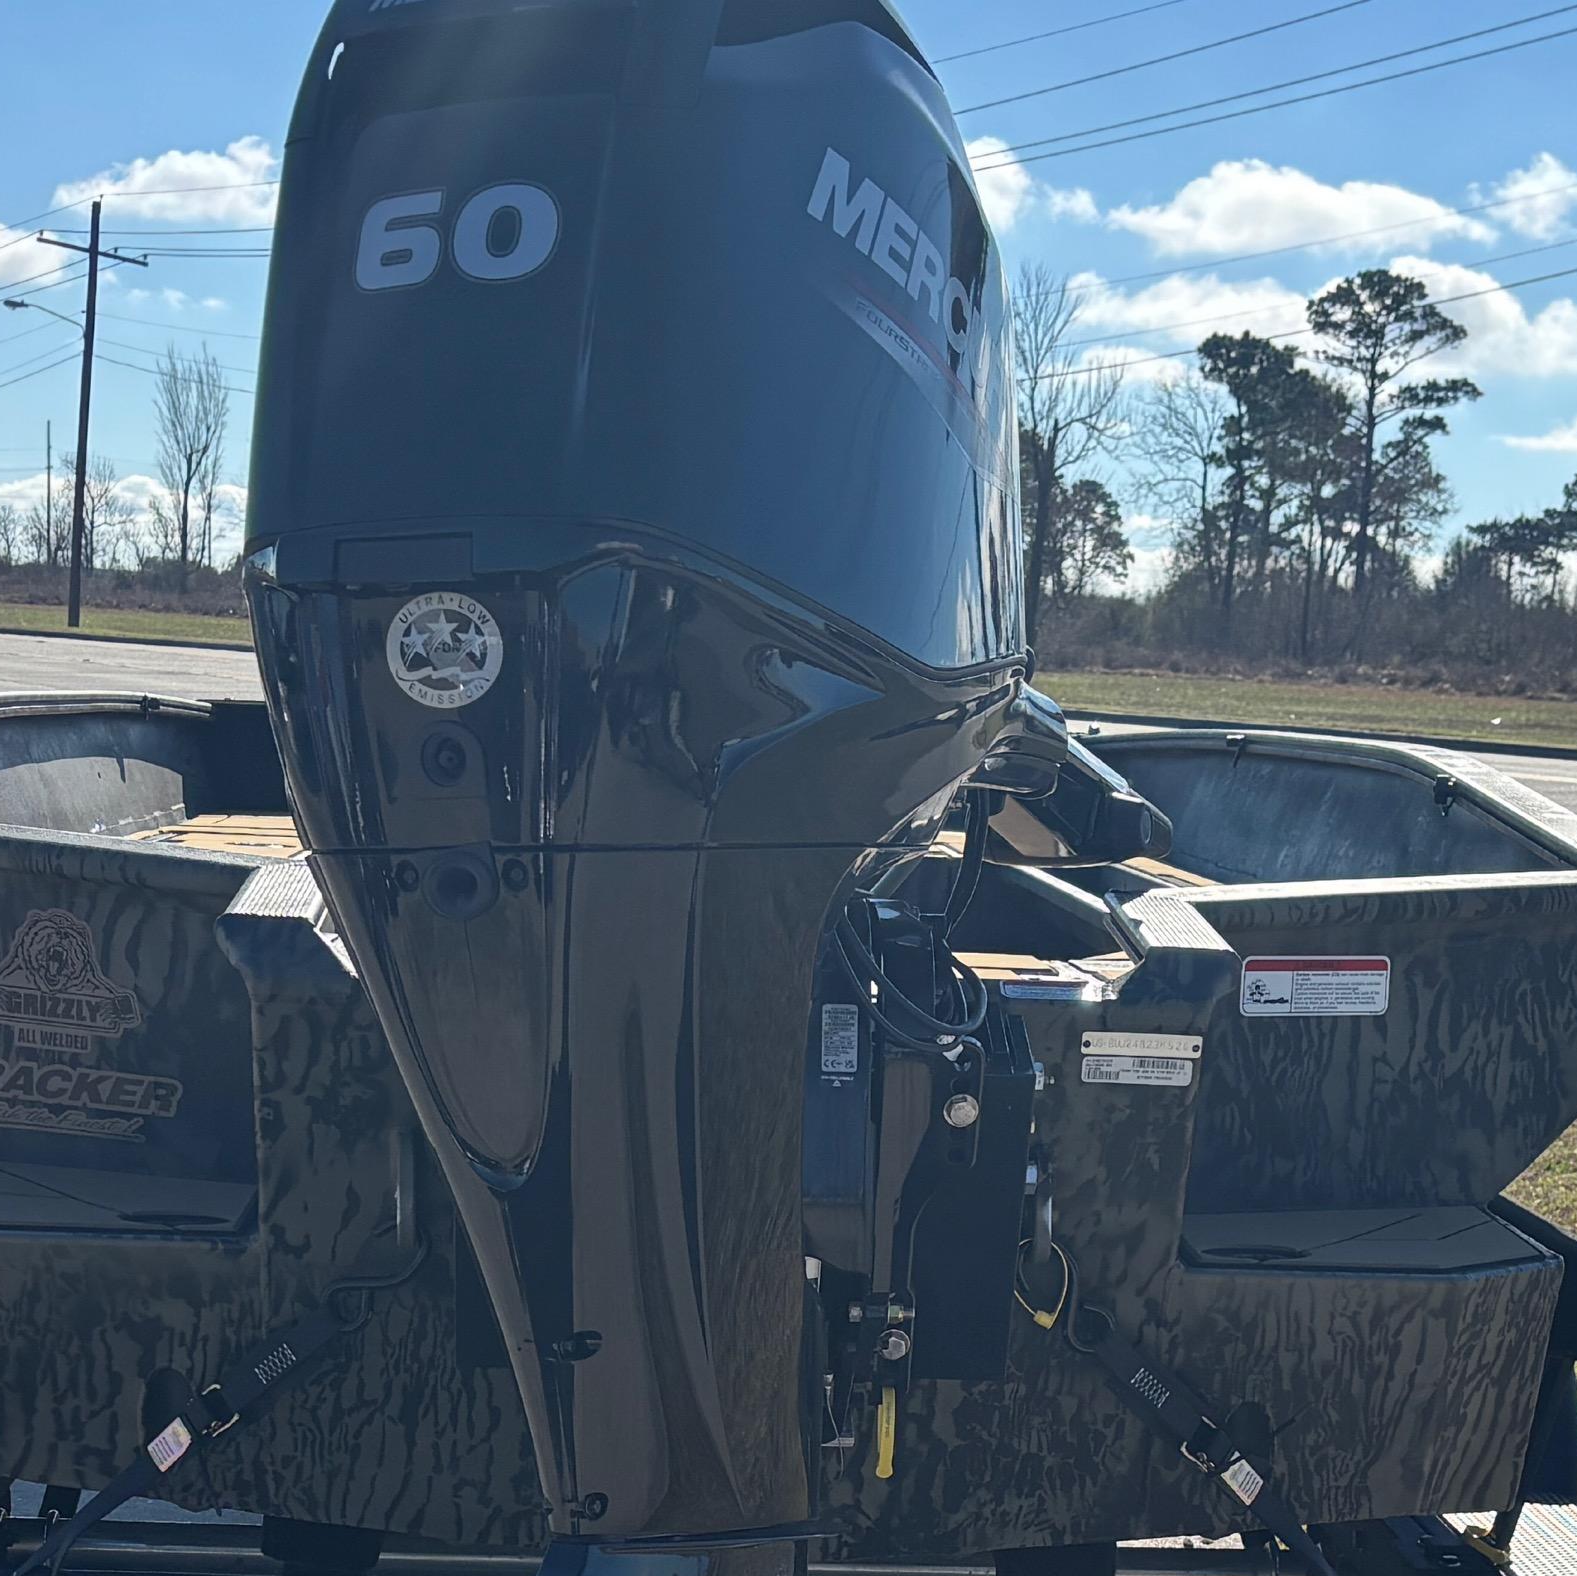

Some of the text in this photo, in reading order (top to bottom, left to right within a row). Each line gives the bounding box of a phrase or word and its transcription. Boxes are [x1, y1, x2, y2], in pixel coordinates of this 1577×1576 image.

[353, 181, 562, 293] 60
[398, 594, 491, 625] ULTRA LOW
[408, 681, 485, 705] EMISSION
[9, 992, 104, 1024] GRIZZLY
[16, 1027, 89, 1050] ALL WELDED
